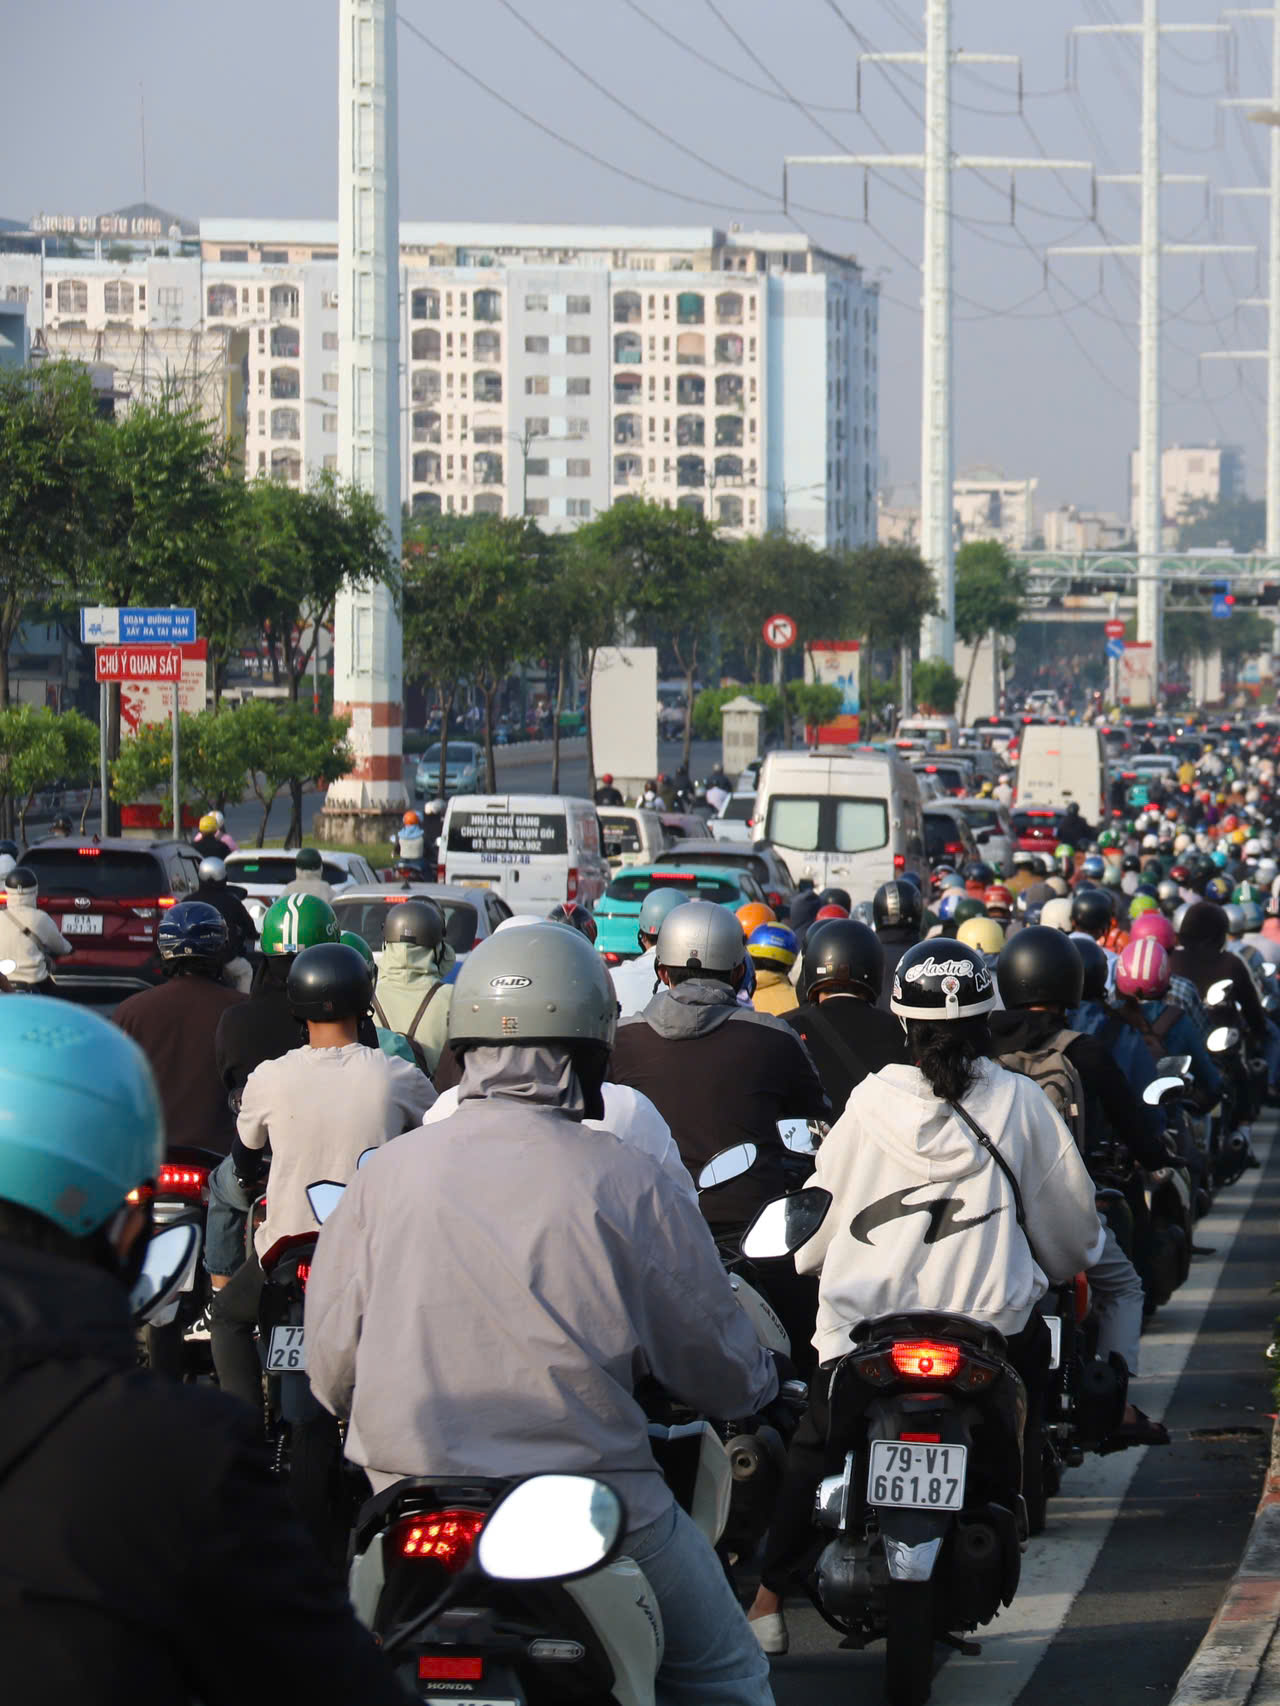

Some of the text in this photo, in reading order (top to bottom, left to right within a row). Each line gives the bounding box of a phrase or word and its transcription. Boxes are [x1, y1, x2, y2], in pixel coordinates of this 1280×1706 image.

[99, 651, 179, 676] CHÚ Ý QUAN SÁT
[885, 1446, 950, 1475] 79-V1
[874, 1475, 959, 1505] 661.87
[426, 1682, 474, 1691] HONDA
